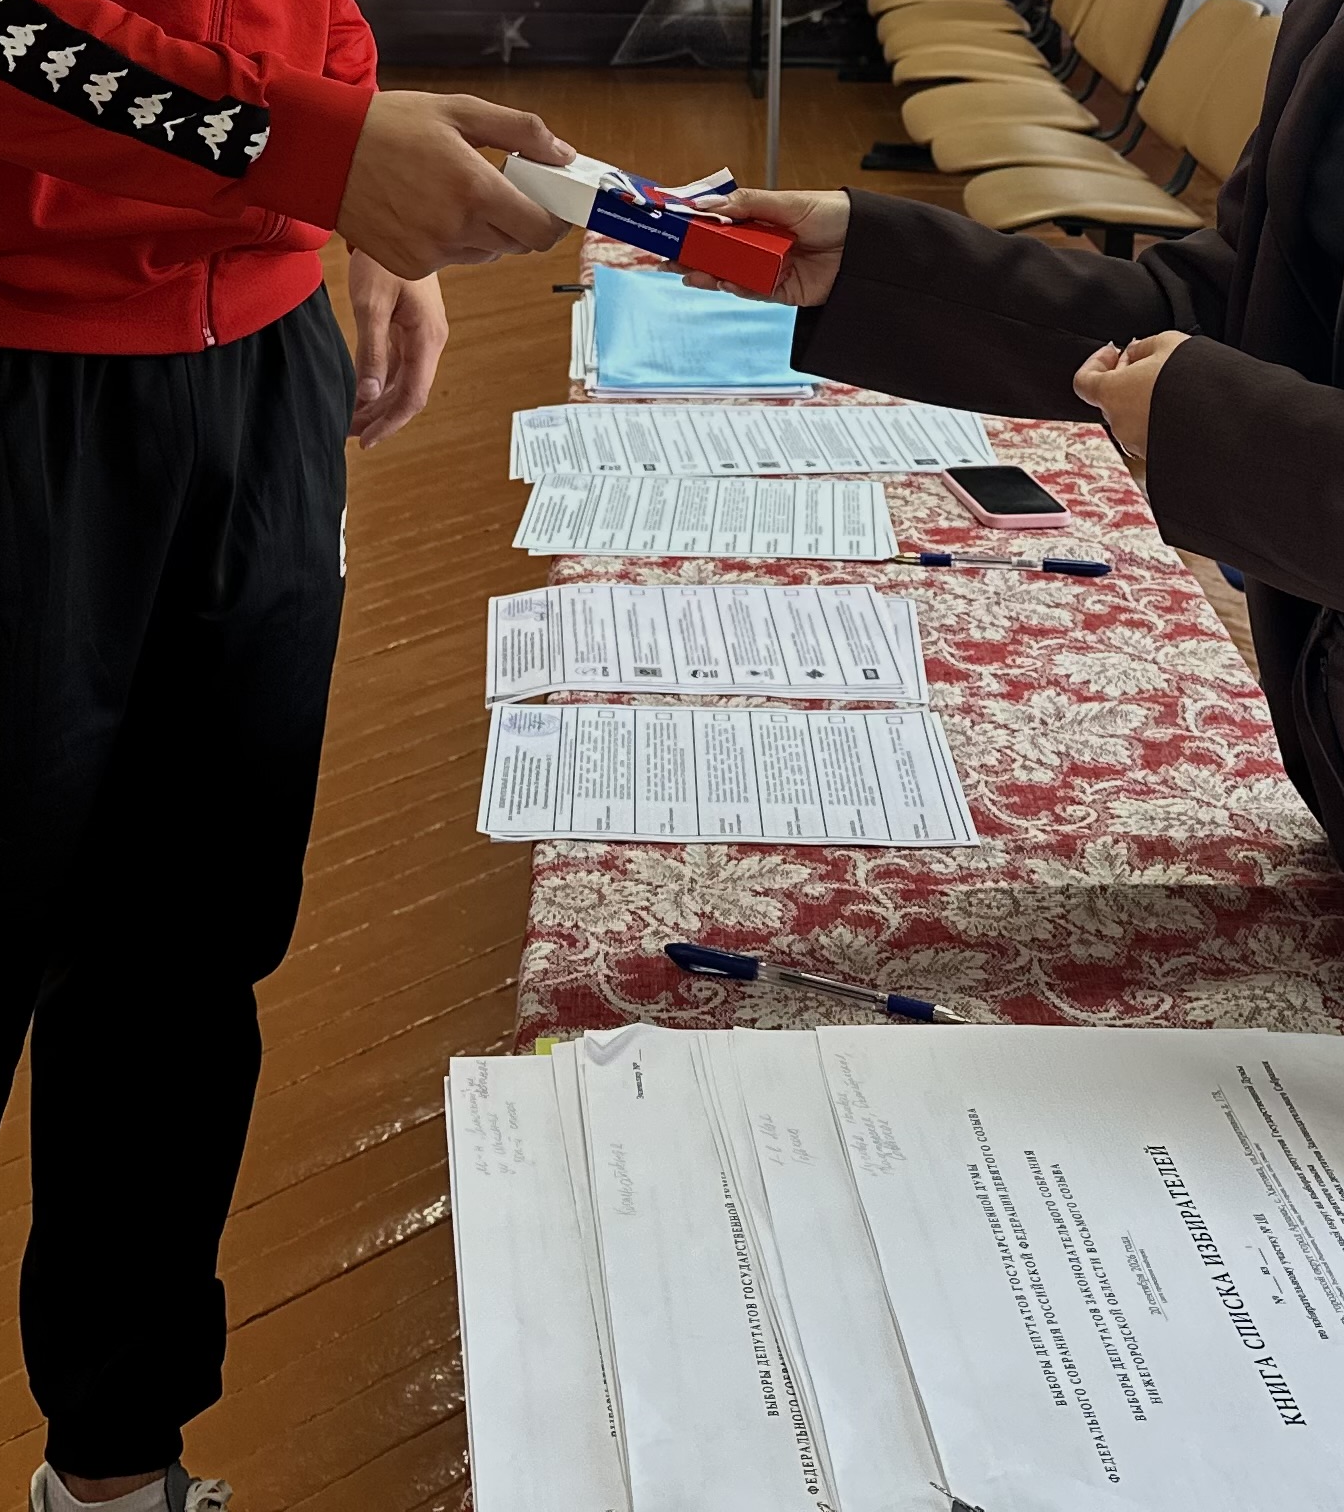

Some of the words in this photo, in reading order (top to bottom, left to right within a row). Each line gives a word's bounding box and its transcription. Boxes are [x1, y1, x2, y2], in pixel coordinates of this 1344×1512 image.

[966, 1108, 988, 1142] СОЗЫВА
[966, 1163, 988, 1191] ДУМЫ
[980, 1144, 1009, 1192] ДЕВЯТОГО
[1023, 1150, 1052, 1198] СОБРАНИЯ
[1049, 1163, 1074, 1199] СОЗЫВА
[998, 1194, 1030, 1249] ФЕДЕРАЦИИ
[1066, 1202, 1098, 1253] ВОСЬМОГО
[1144, 1144, 1225, 1266] ИЗБИРАТЕЛЕЙ
[724, 1202, 756, 1300] ГОСУДАРСТВЕННОЙ
[975, 1194, 1024, 1291] ГОСУДАРСТВЕННОЙ
[1044, 1200, 1097, 1304] ЗАКОНОДАТЕЛЬНОГО
[1019, 1252, 1058, 1324] РОССИЙСКОЙ
[1089, 1257, 1119, 1305] ОБЛАСТИ
[1211, 1271, 1266, 1350] СПИСКА
[745, 1303, 771, 1366] ДЕПУТАТОВ
[1014, 1294, 1050, 1357] ДЕПУТАТОВ
[1049, 1327, 1082, 1384] СОБРАНИЯ
[1088, 1307, 1127, 1370] ДЕПУТАТОВ
[1108, 1308, 1164, 1404] НИЖЕГОРОДСКОЙ
[758, 1370, 780, 1416] ВЫБОРЫ
[1038, 1359, 1068, 1406] ВЫБОРЫ
[1116, 1373, 1148, 1421] ВЫБОРЫ
[1253, 1356, 1308, 1426] КНИГА
[788, 1397, 820, 1495] ФЕДЕРАЛЬНОГО
[1074, 1388, 1121, 1483] ФЕДЕРАЛЬНОГО
